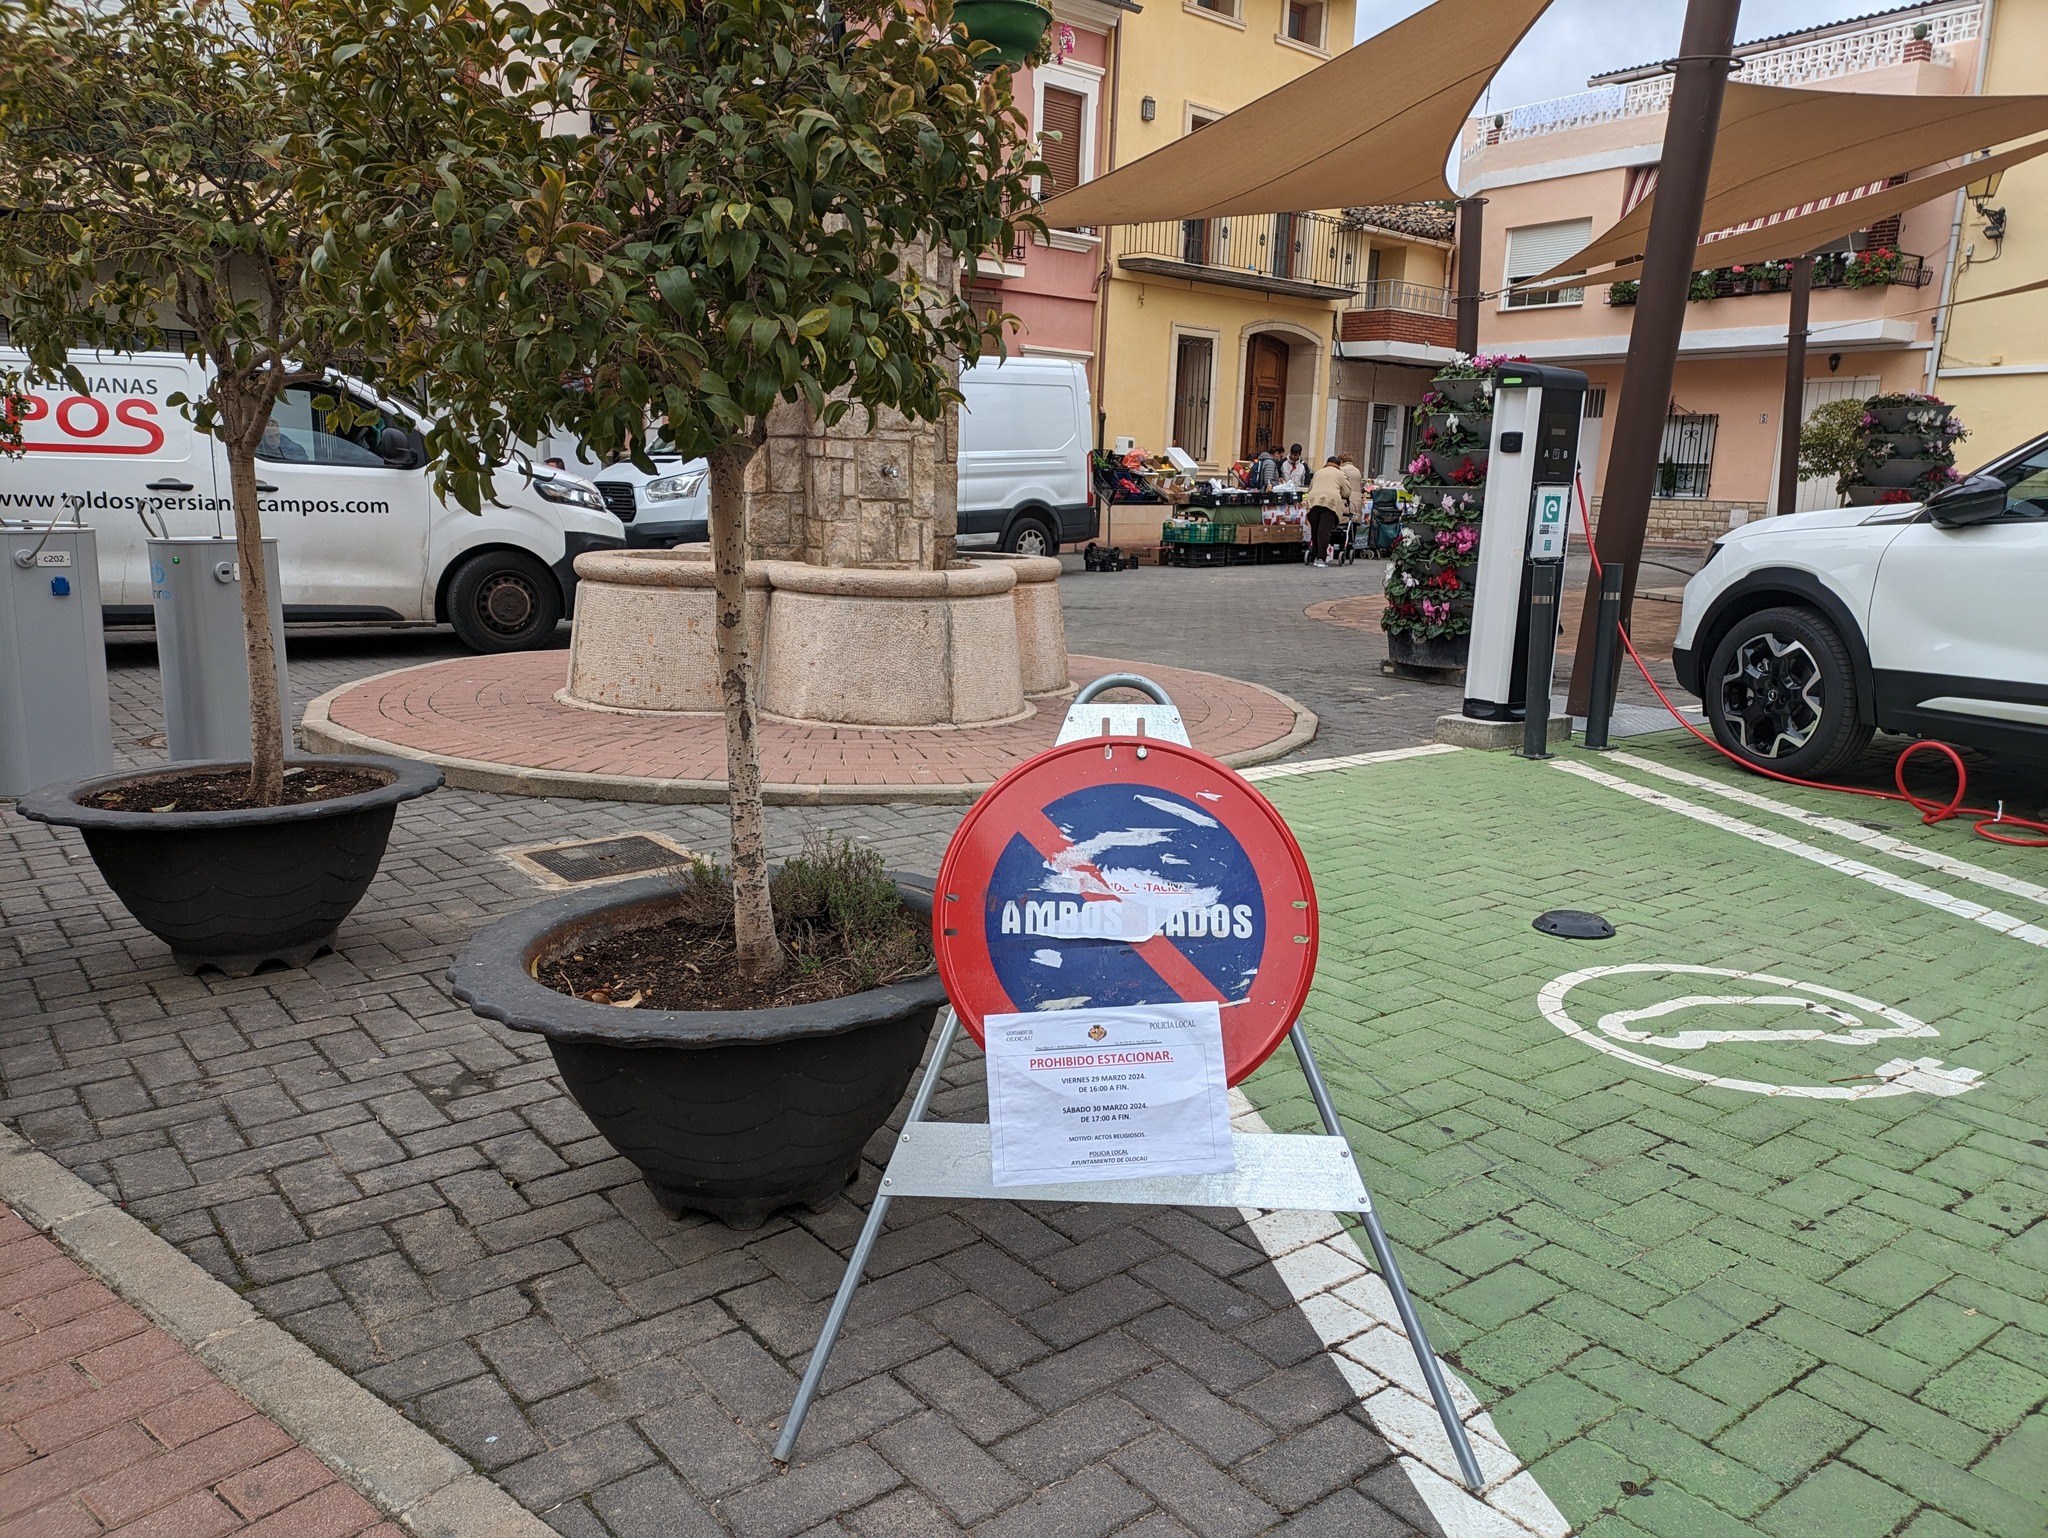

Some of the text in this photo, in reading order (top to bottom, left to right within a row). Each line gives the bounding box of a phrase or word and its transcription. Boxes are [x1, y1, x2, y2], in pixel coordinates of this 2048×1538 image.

[31, 374, 159, 395] PERIANAS
[1543, 449, 1569, 459] A B
[43, 554, 65, 563] c202
[1001, 899, 1254, 939] AMBOS LADOS
[1149, 1019, 1196, 1030] POLICÍA LOCAL
[1061, 1076, 1090, 1084] VIERNES
[1101, 1074, 1127, 1082] MARZO
[1128, 1073, 1147, 1081] 2024.
[1089, 1085, 1108, 1093] 16:00
[1062, 1106, 1091, 1114] SÁBADO
[1071, 1157, 1116, 1166] AYUNTAMIENTO
